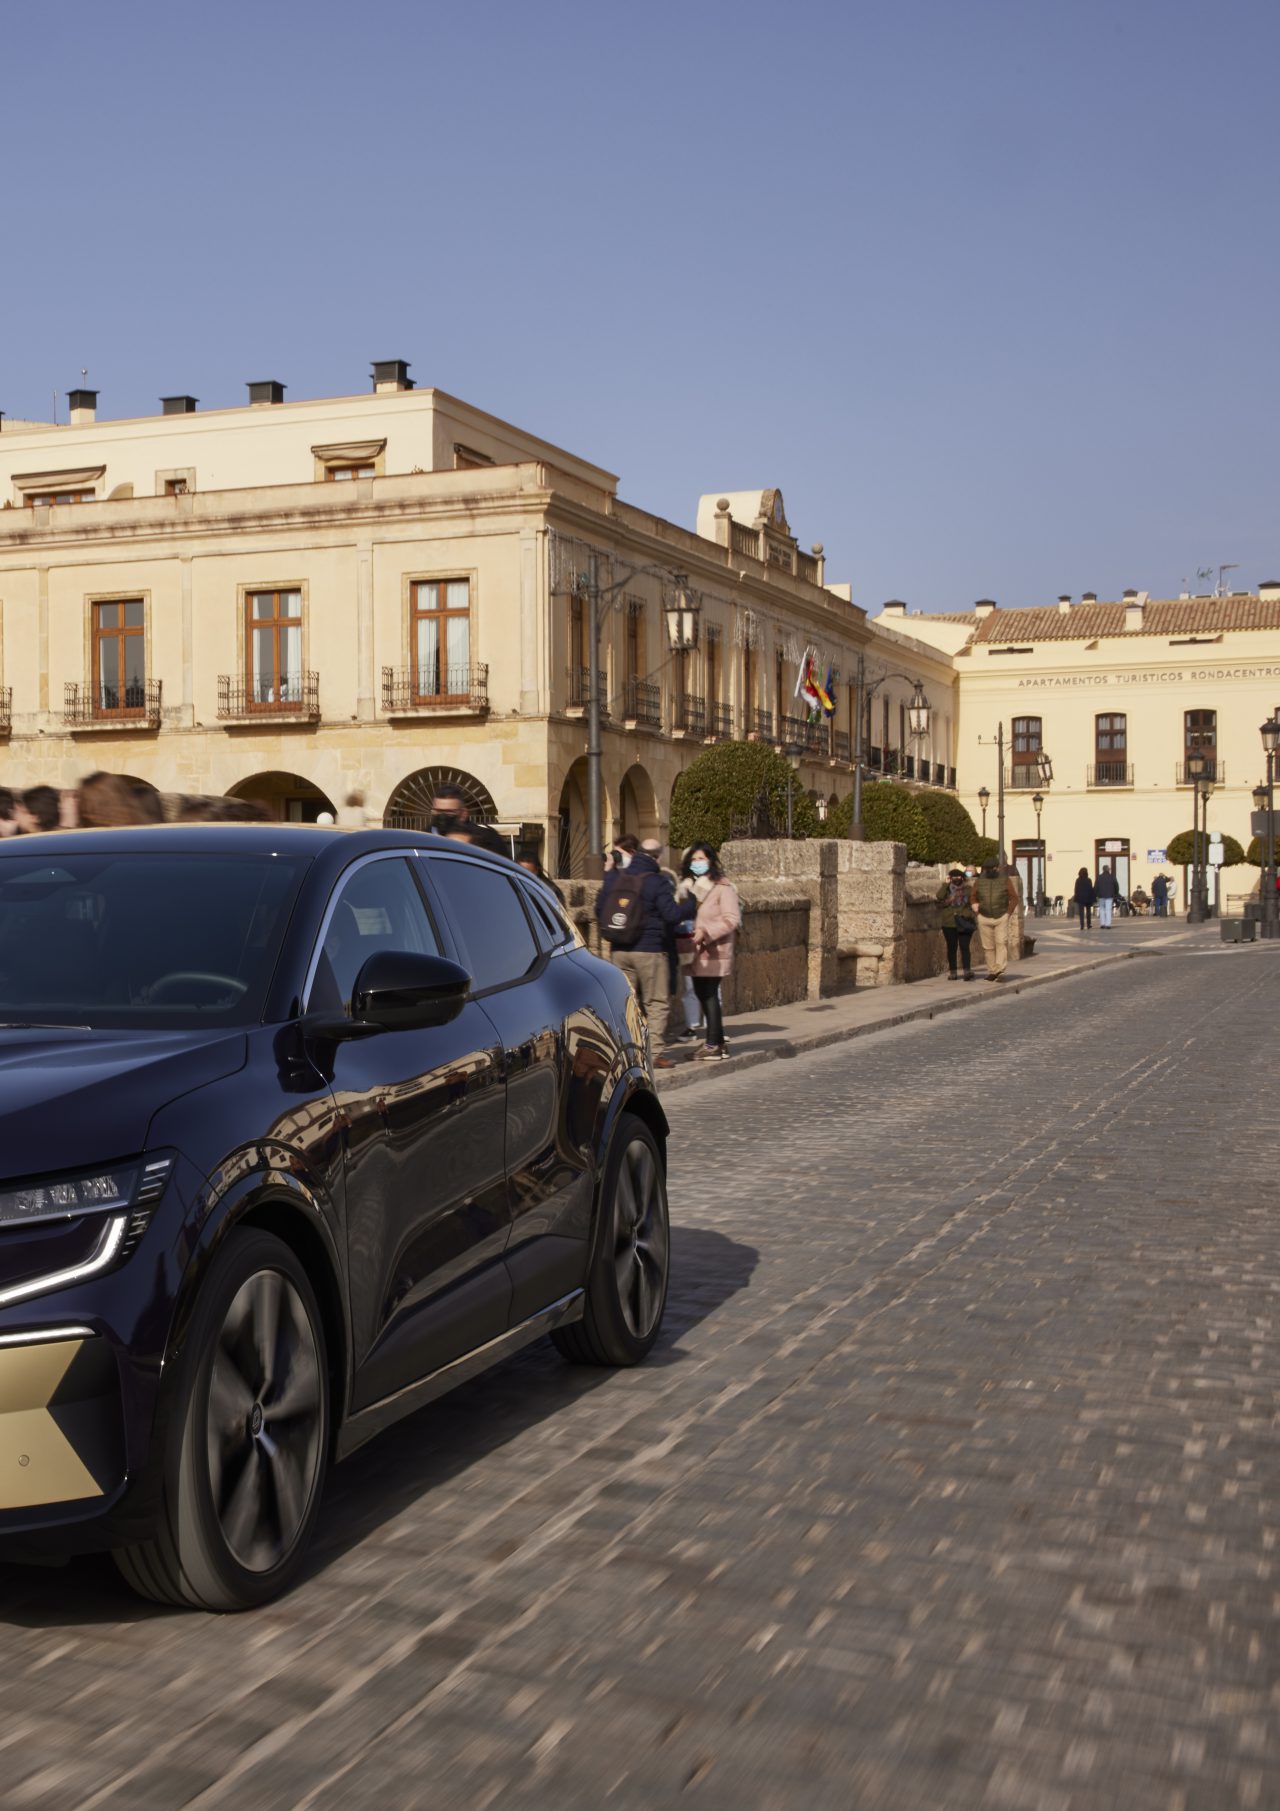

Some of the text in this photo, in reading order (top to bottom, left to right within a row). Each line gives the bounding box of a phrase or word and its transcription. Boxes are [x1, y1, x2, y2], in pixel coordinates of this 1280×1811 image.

[1018, 667, 1280, 688] APARTAMENTOS TURISTICOS RONDACENTRO
